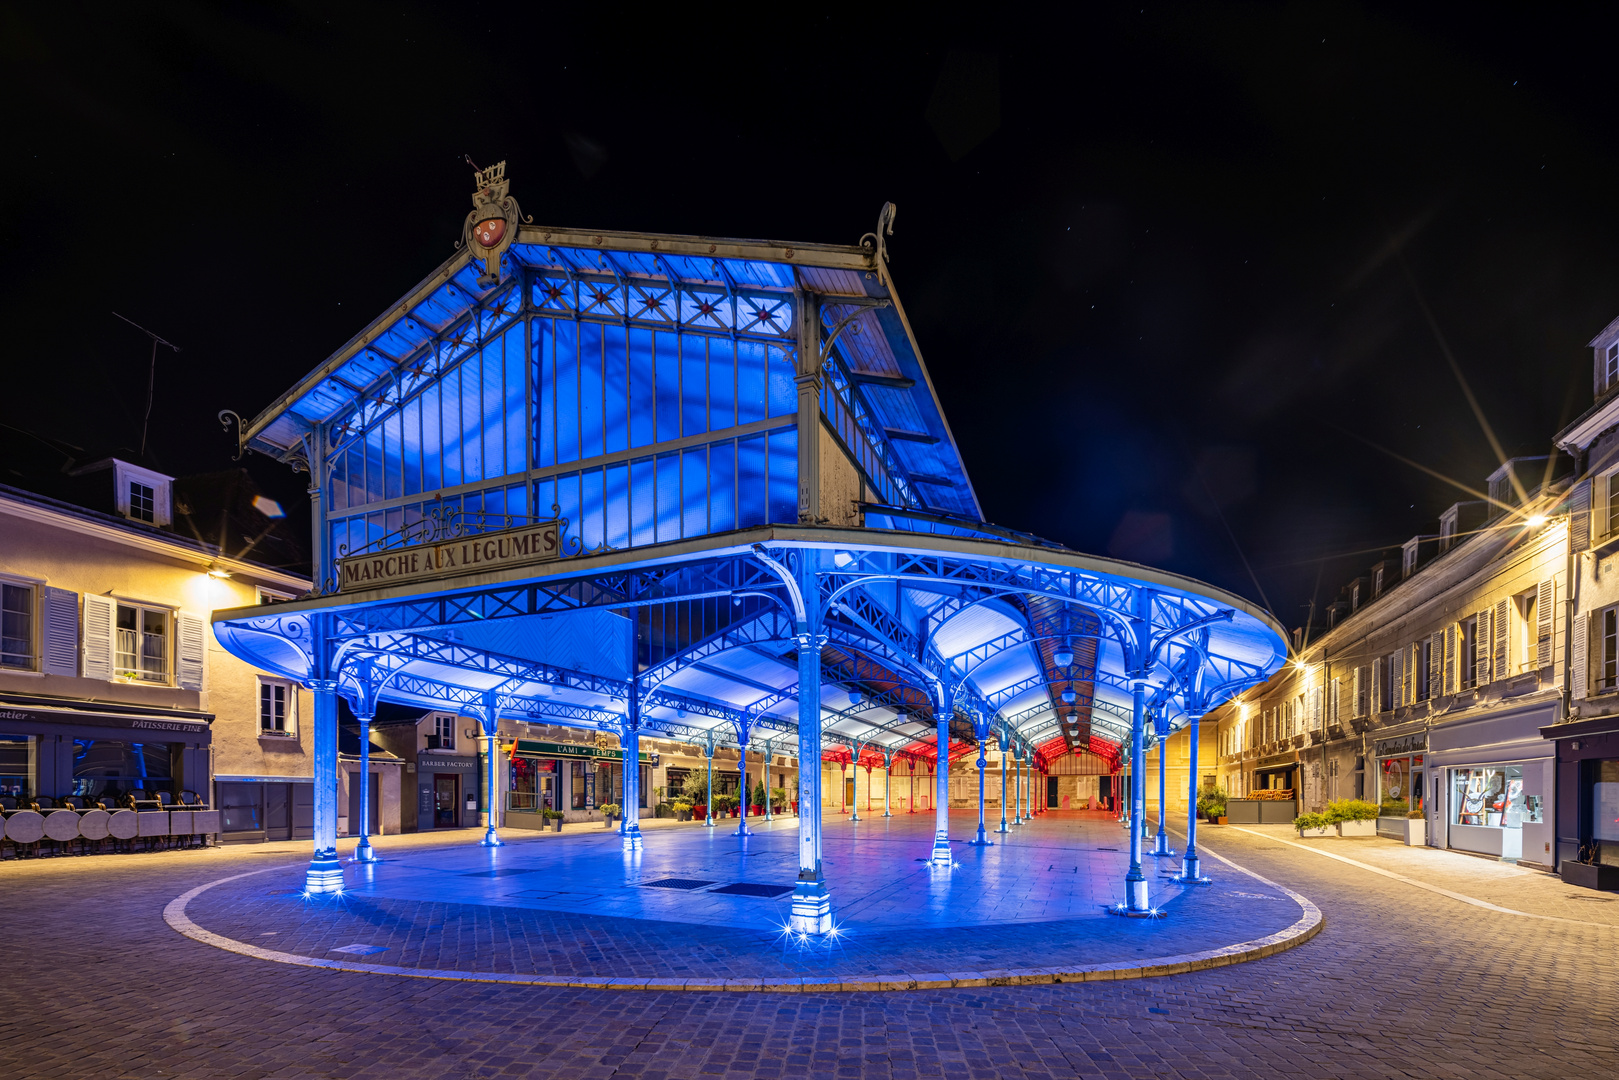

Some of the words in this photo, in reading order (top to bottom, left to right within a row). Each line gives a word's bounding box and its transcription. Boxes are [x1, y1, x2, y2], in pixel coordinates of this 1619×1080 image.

[345, 553, 419, 583] MARCHE
[423, 547, 456, 572] AUX
[462, 530, 557, 565] LEGUMES
[132, 720, 181, 731] PÂTISSERIE
[182, 724, 202, 733] FINE
[557, 745, 578, 754] L'AMI
[592, 749, 617, 758] TEMPS
